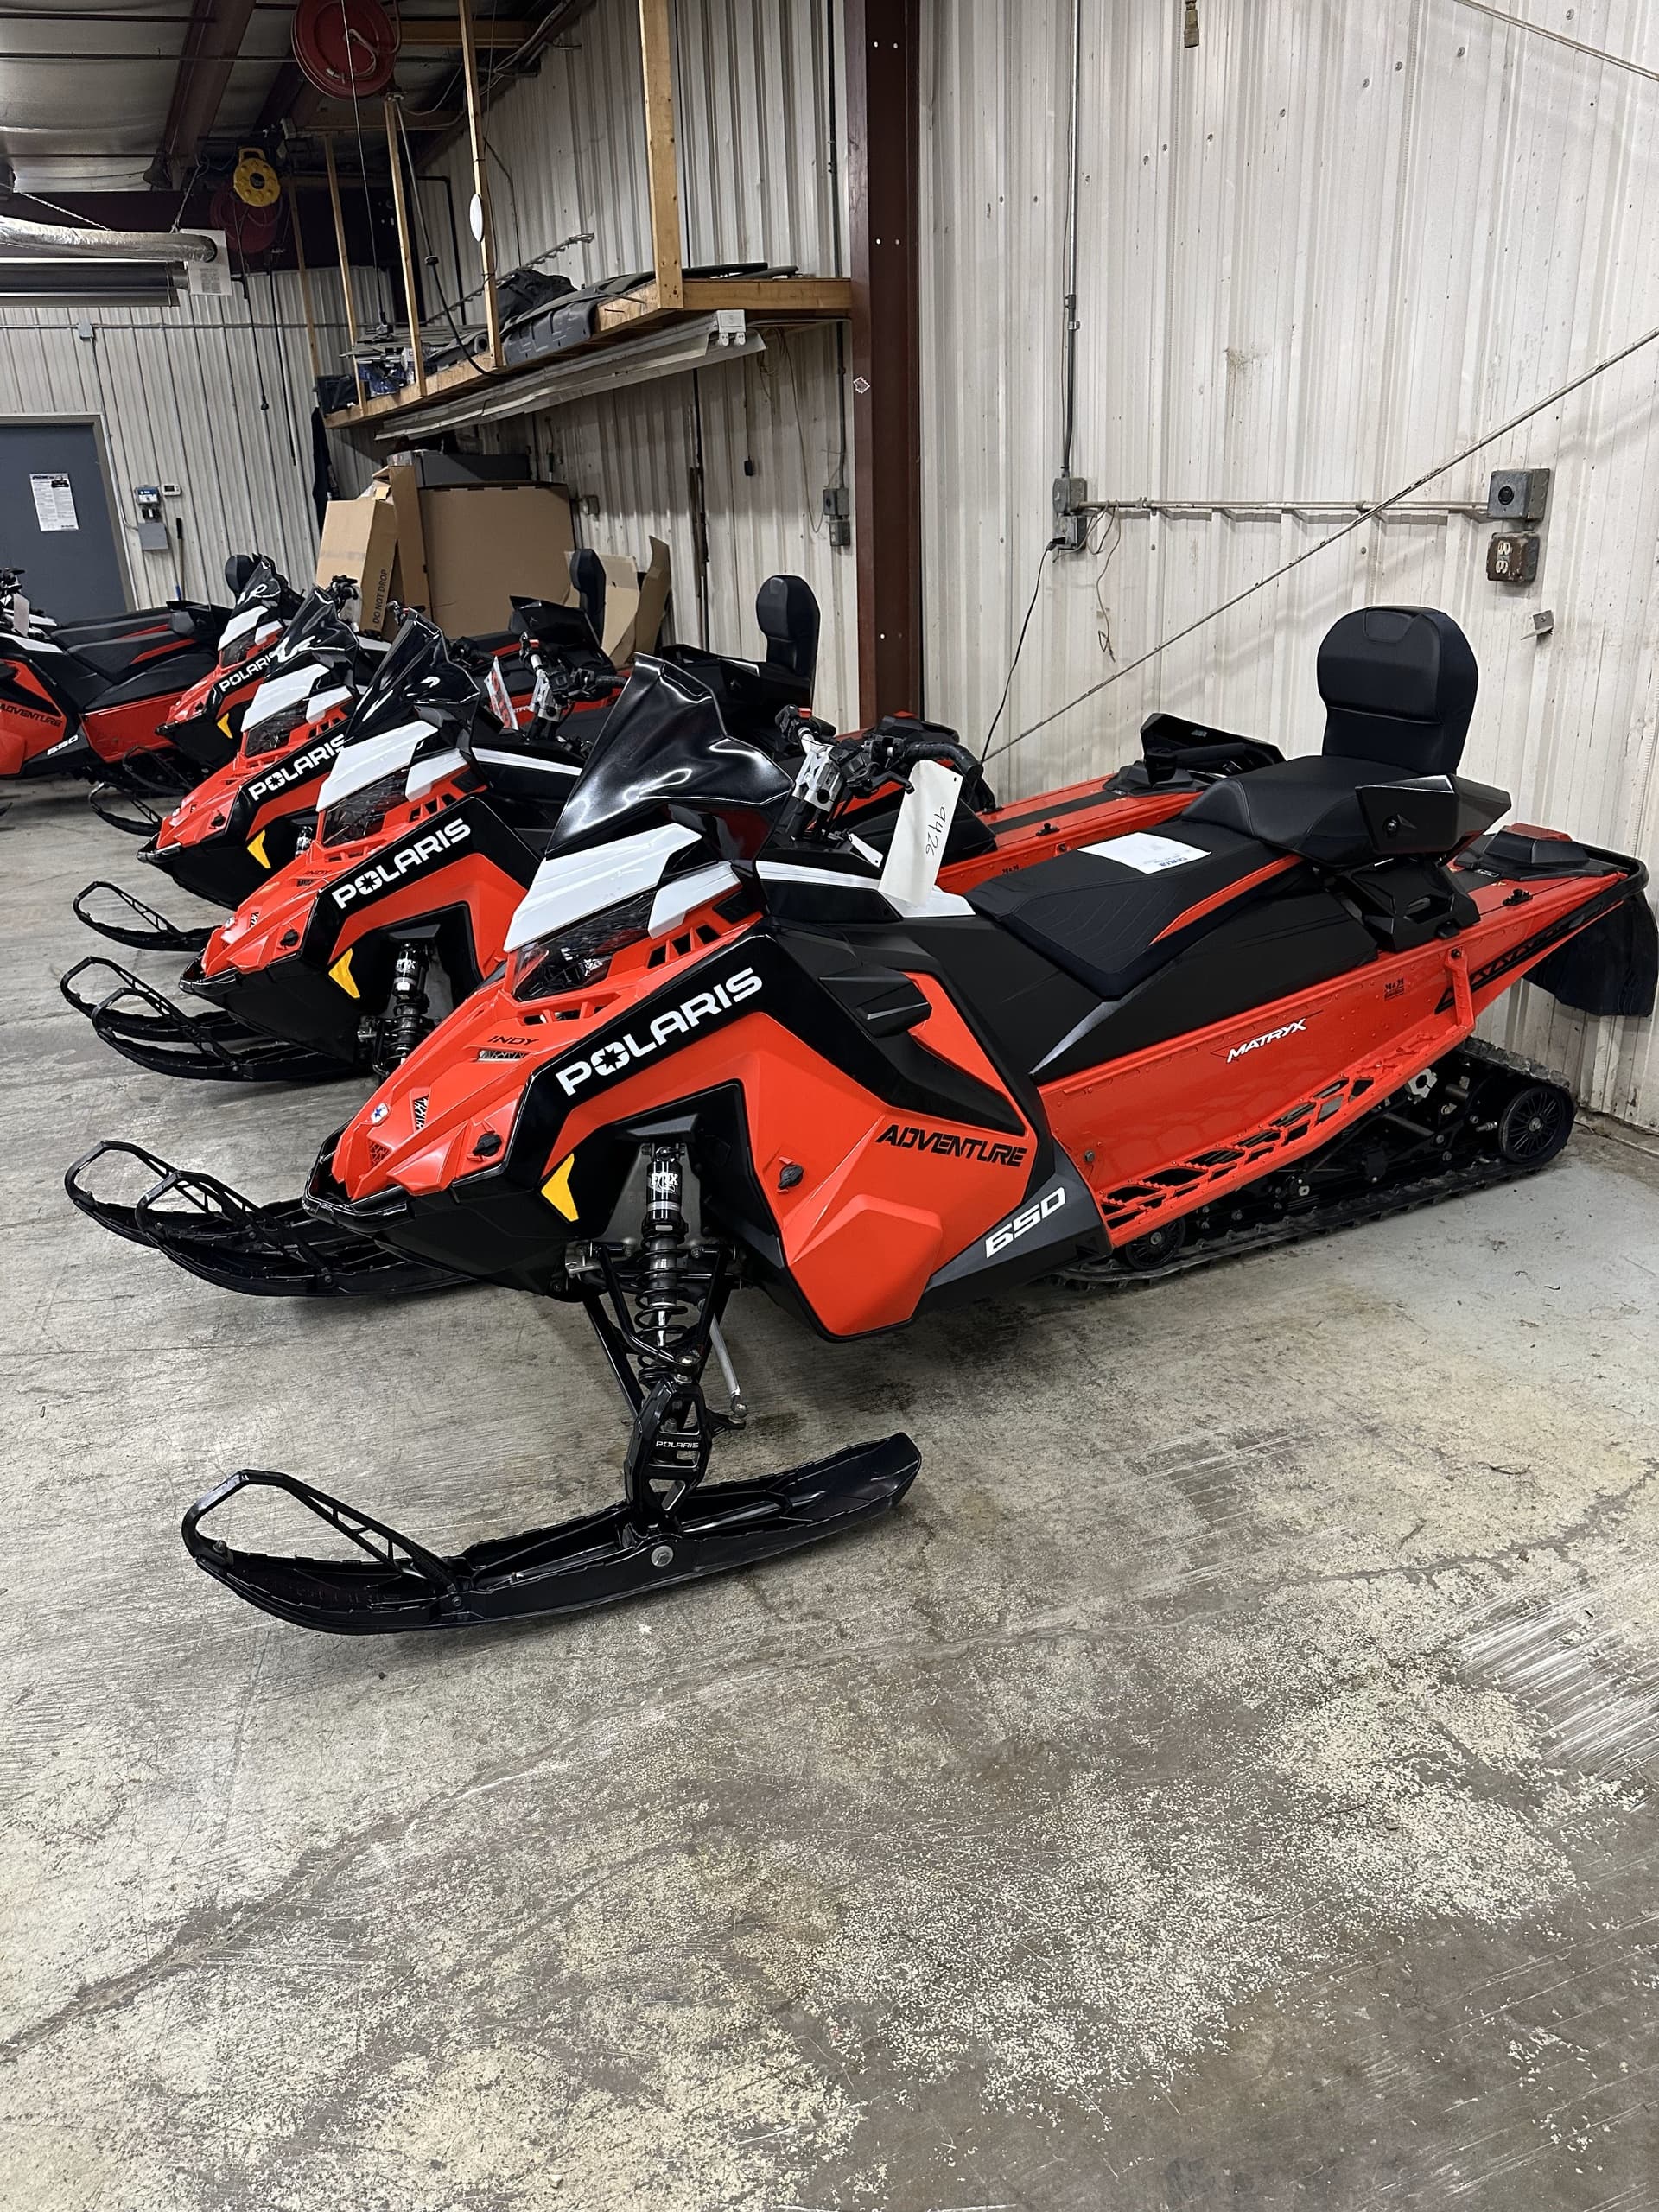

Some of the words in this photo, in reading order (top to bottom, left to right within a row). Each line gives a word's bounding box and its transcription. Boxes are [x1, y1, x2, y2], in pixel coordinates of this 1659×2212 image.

[376, 593, 385, 610] NOT
[379, 569, 388, 592] DROP
[373, 610, 382, 623] DO
[248, 734, 346, 801] POLARIS
[925, 806, 946, 856] 9426
[331, 817, 471, 910] POLARIS
[487, 1035, 540, 1046] INDY
[555, 967, 763, 1096] POLARIS
[1227, 1018, 1307, 1063] MATRYX
[875, 1124, 1027, 1168] ADVENTURE
[651, 1172, 679, 1186] FOX
[985, 1186, 1066, 1259] 650
